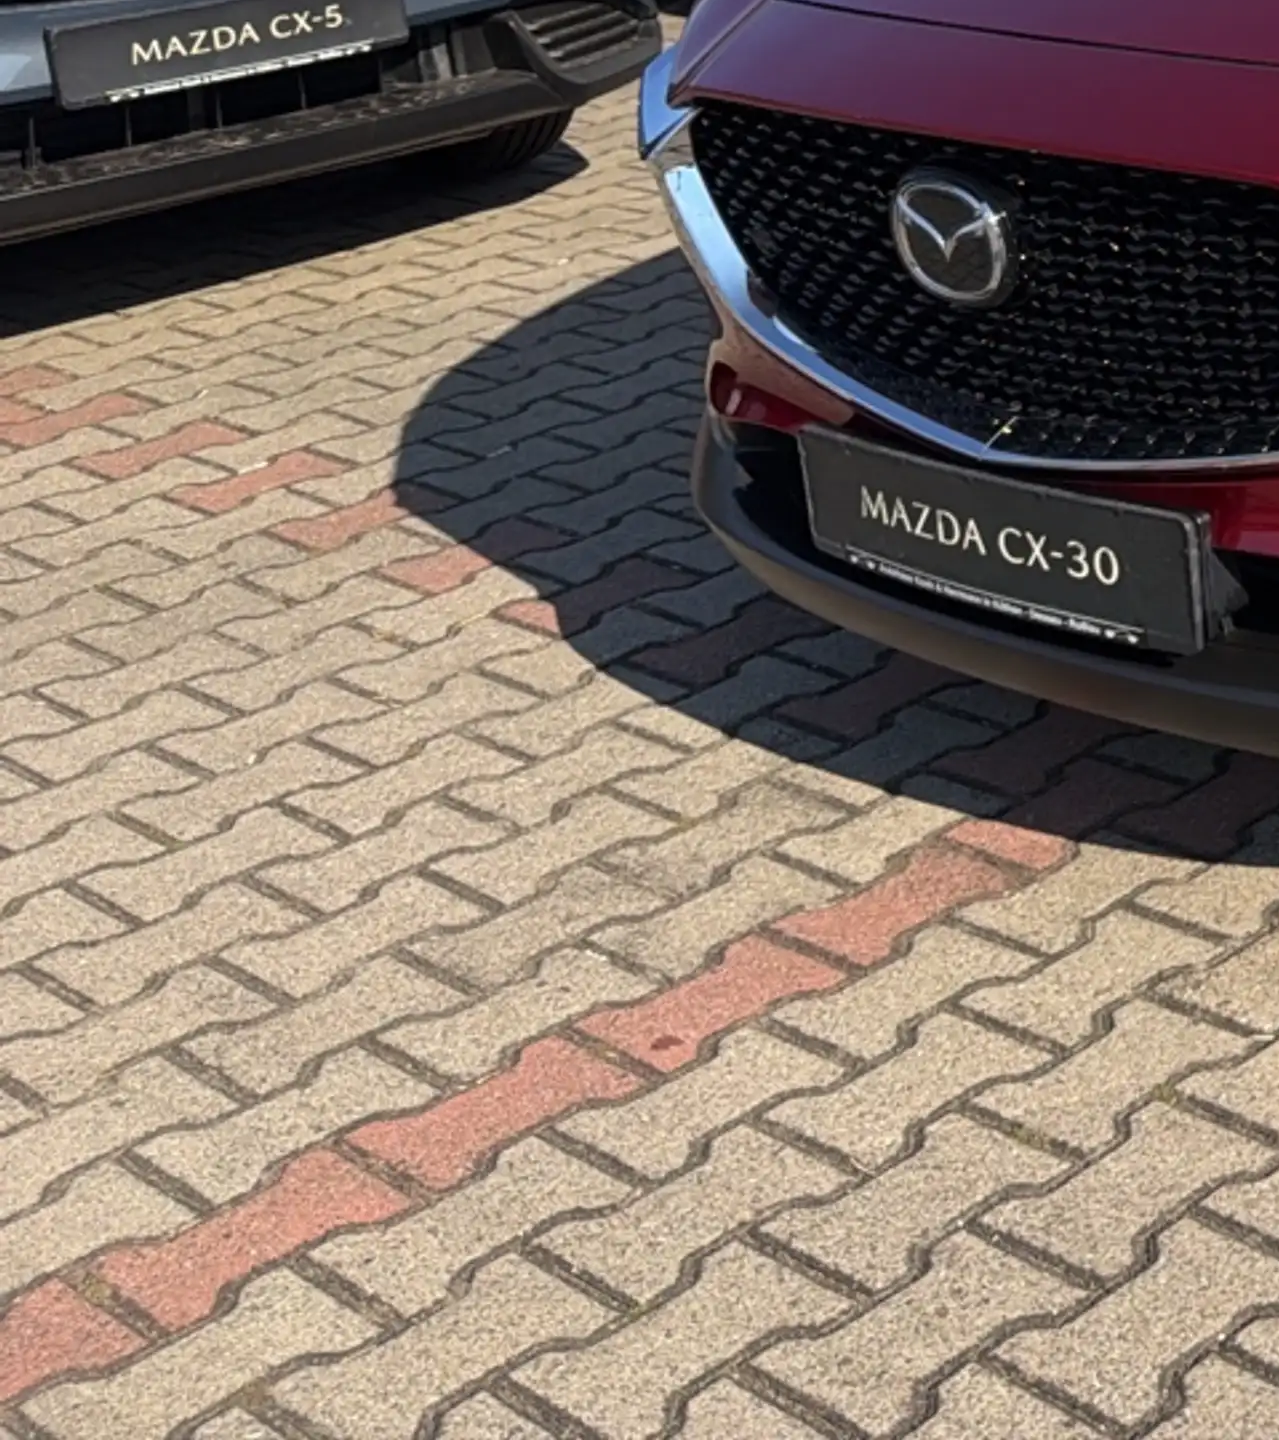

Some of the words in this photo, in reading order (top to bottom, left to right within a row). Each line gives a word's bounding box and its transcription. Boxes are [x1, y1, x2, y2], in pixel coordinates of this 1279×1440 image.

[130, 21, 261, 66] MAZDA
[269, 3, 344, 40] CX-5
[859, 484, 988, 557] MAZDA
[997, 526, 1121, 586] CX-30
